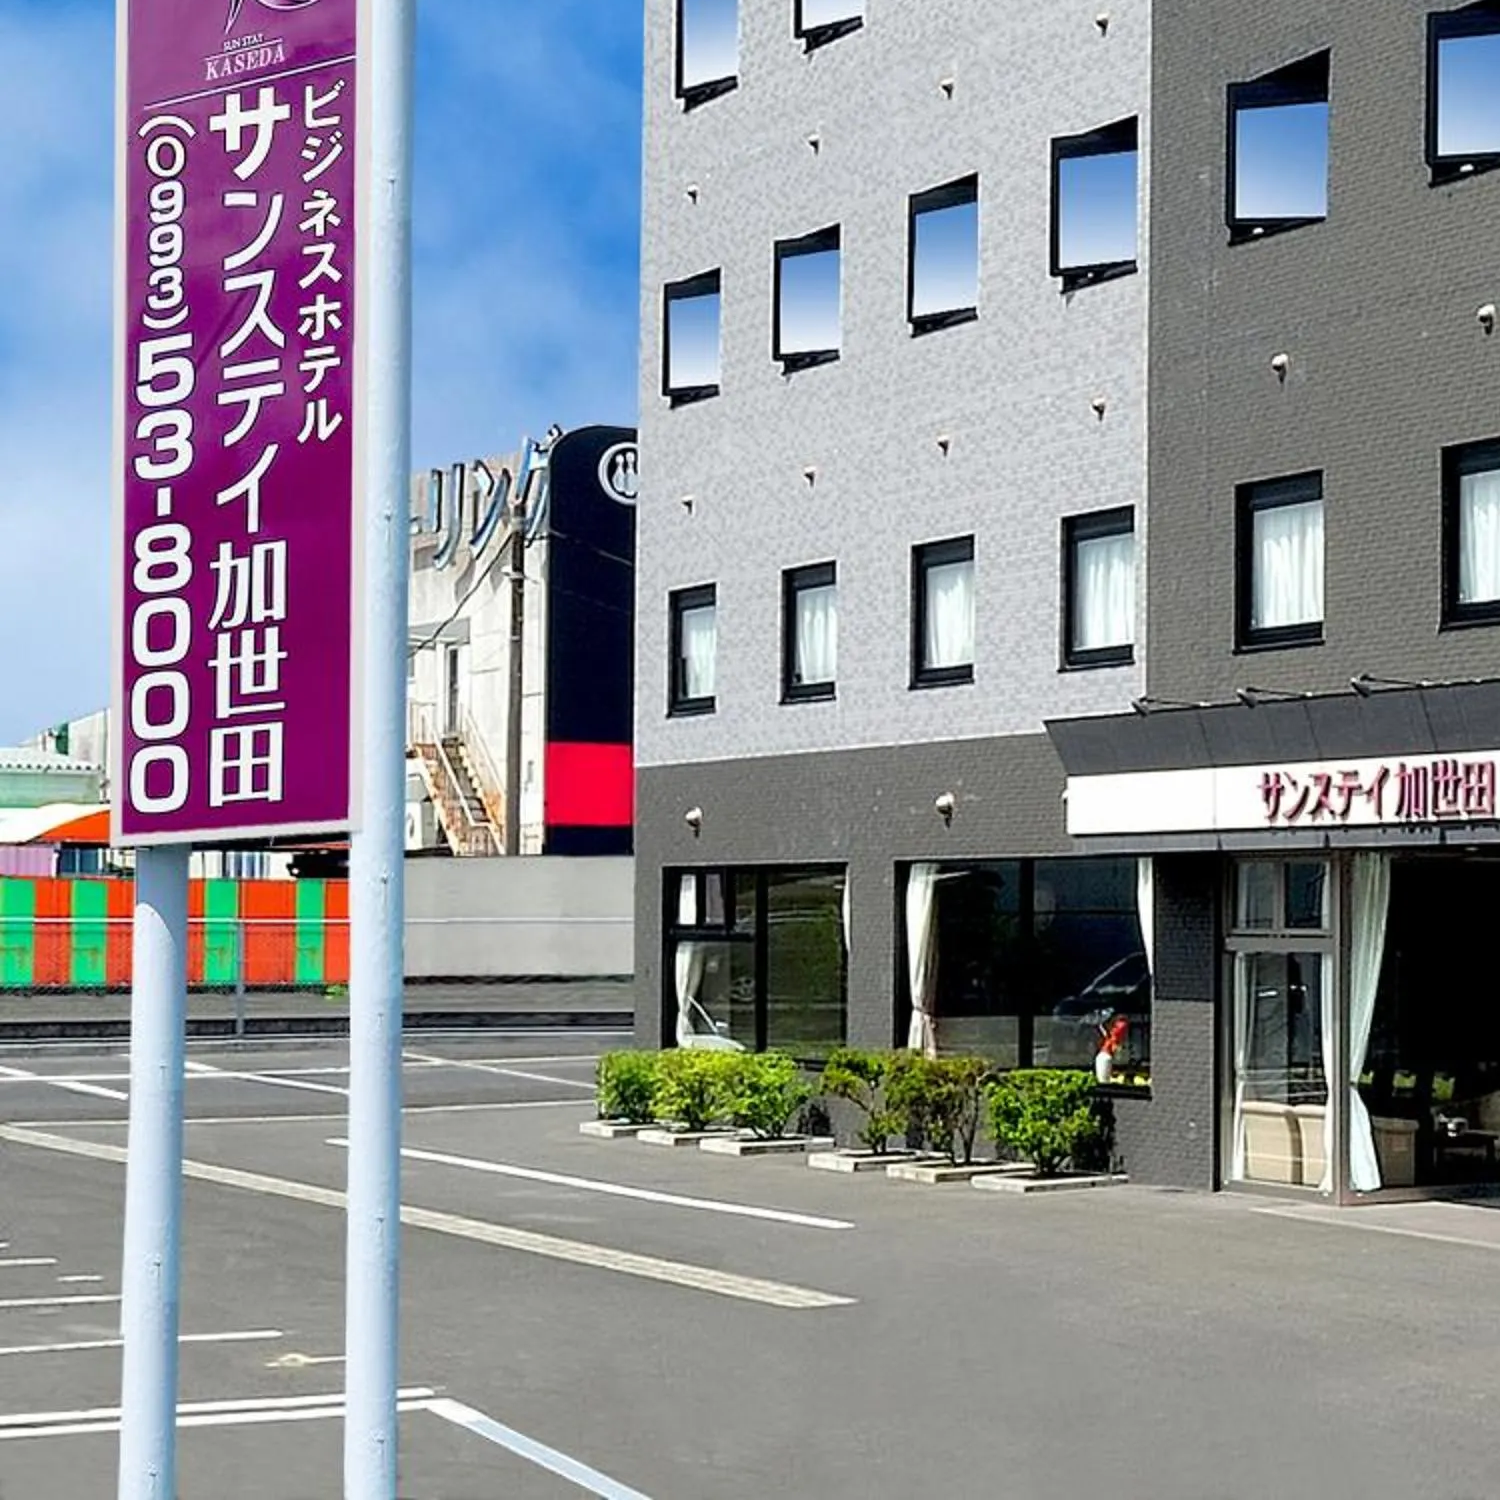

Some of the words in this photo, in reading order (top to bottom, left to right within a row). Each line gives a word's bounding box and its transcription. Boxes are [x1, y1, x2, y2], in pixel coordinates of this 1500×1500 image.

[205, 44, 286, 82] KASEDA
[297, 79, 345, 444] ビジネスホテル
[129, 114, 197, 814] (0993)53-8000
[207, 85, 292, 808] サンステイ加世田
[1257, 759, 1496, 822] サンステイ加世田
